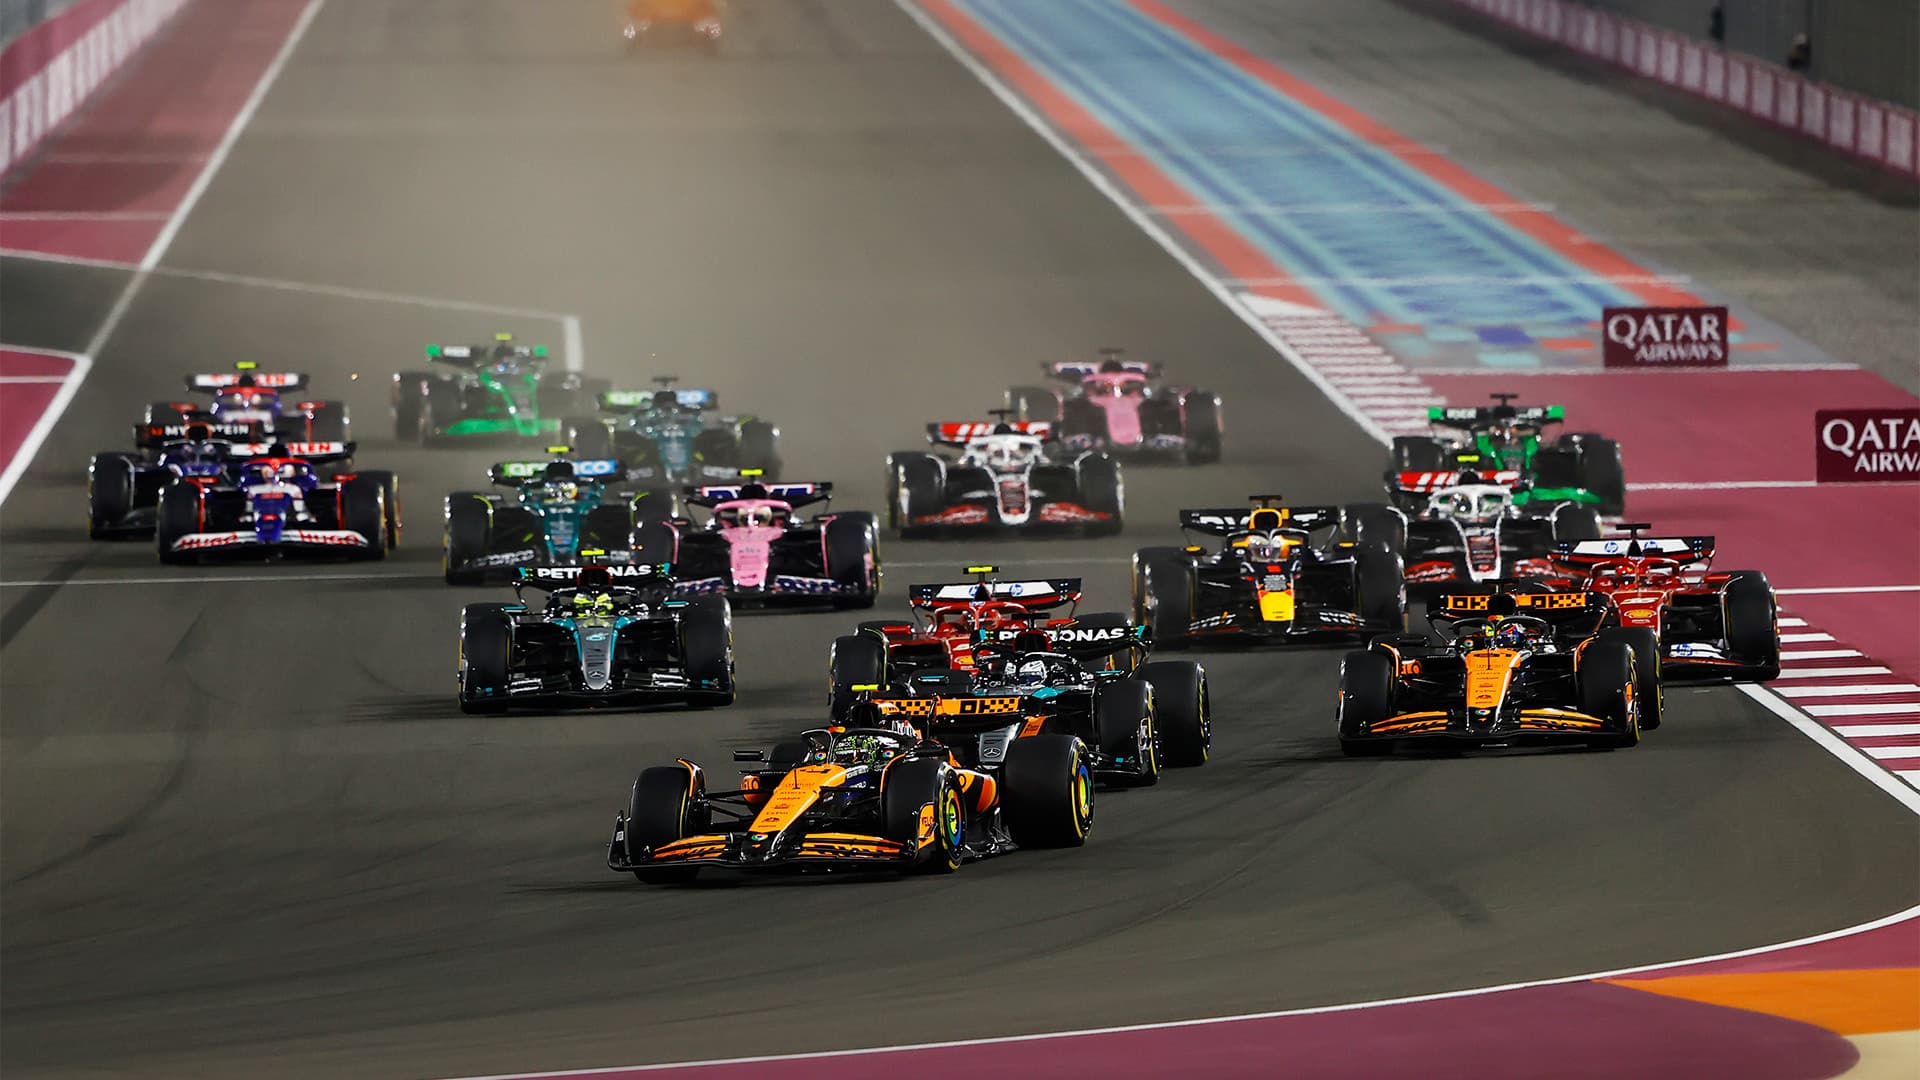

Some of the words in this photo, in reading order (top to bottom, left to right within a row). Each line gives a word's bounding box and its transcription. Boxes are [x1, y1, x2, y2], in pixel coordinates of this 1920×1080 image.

[1608, 313, 1720, 349] QATAR
[1634, 343, 1723, 361] AIRWAYS
[1854, 452, 1920, 472] AIRW
[537, 564, 651, 579] PETNAS
